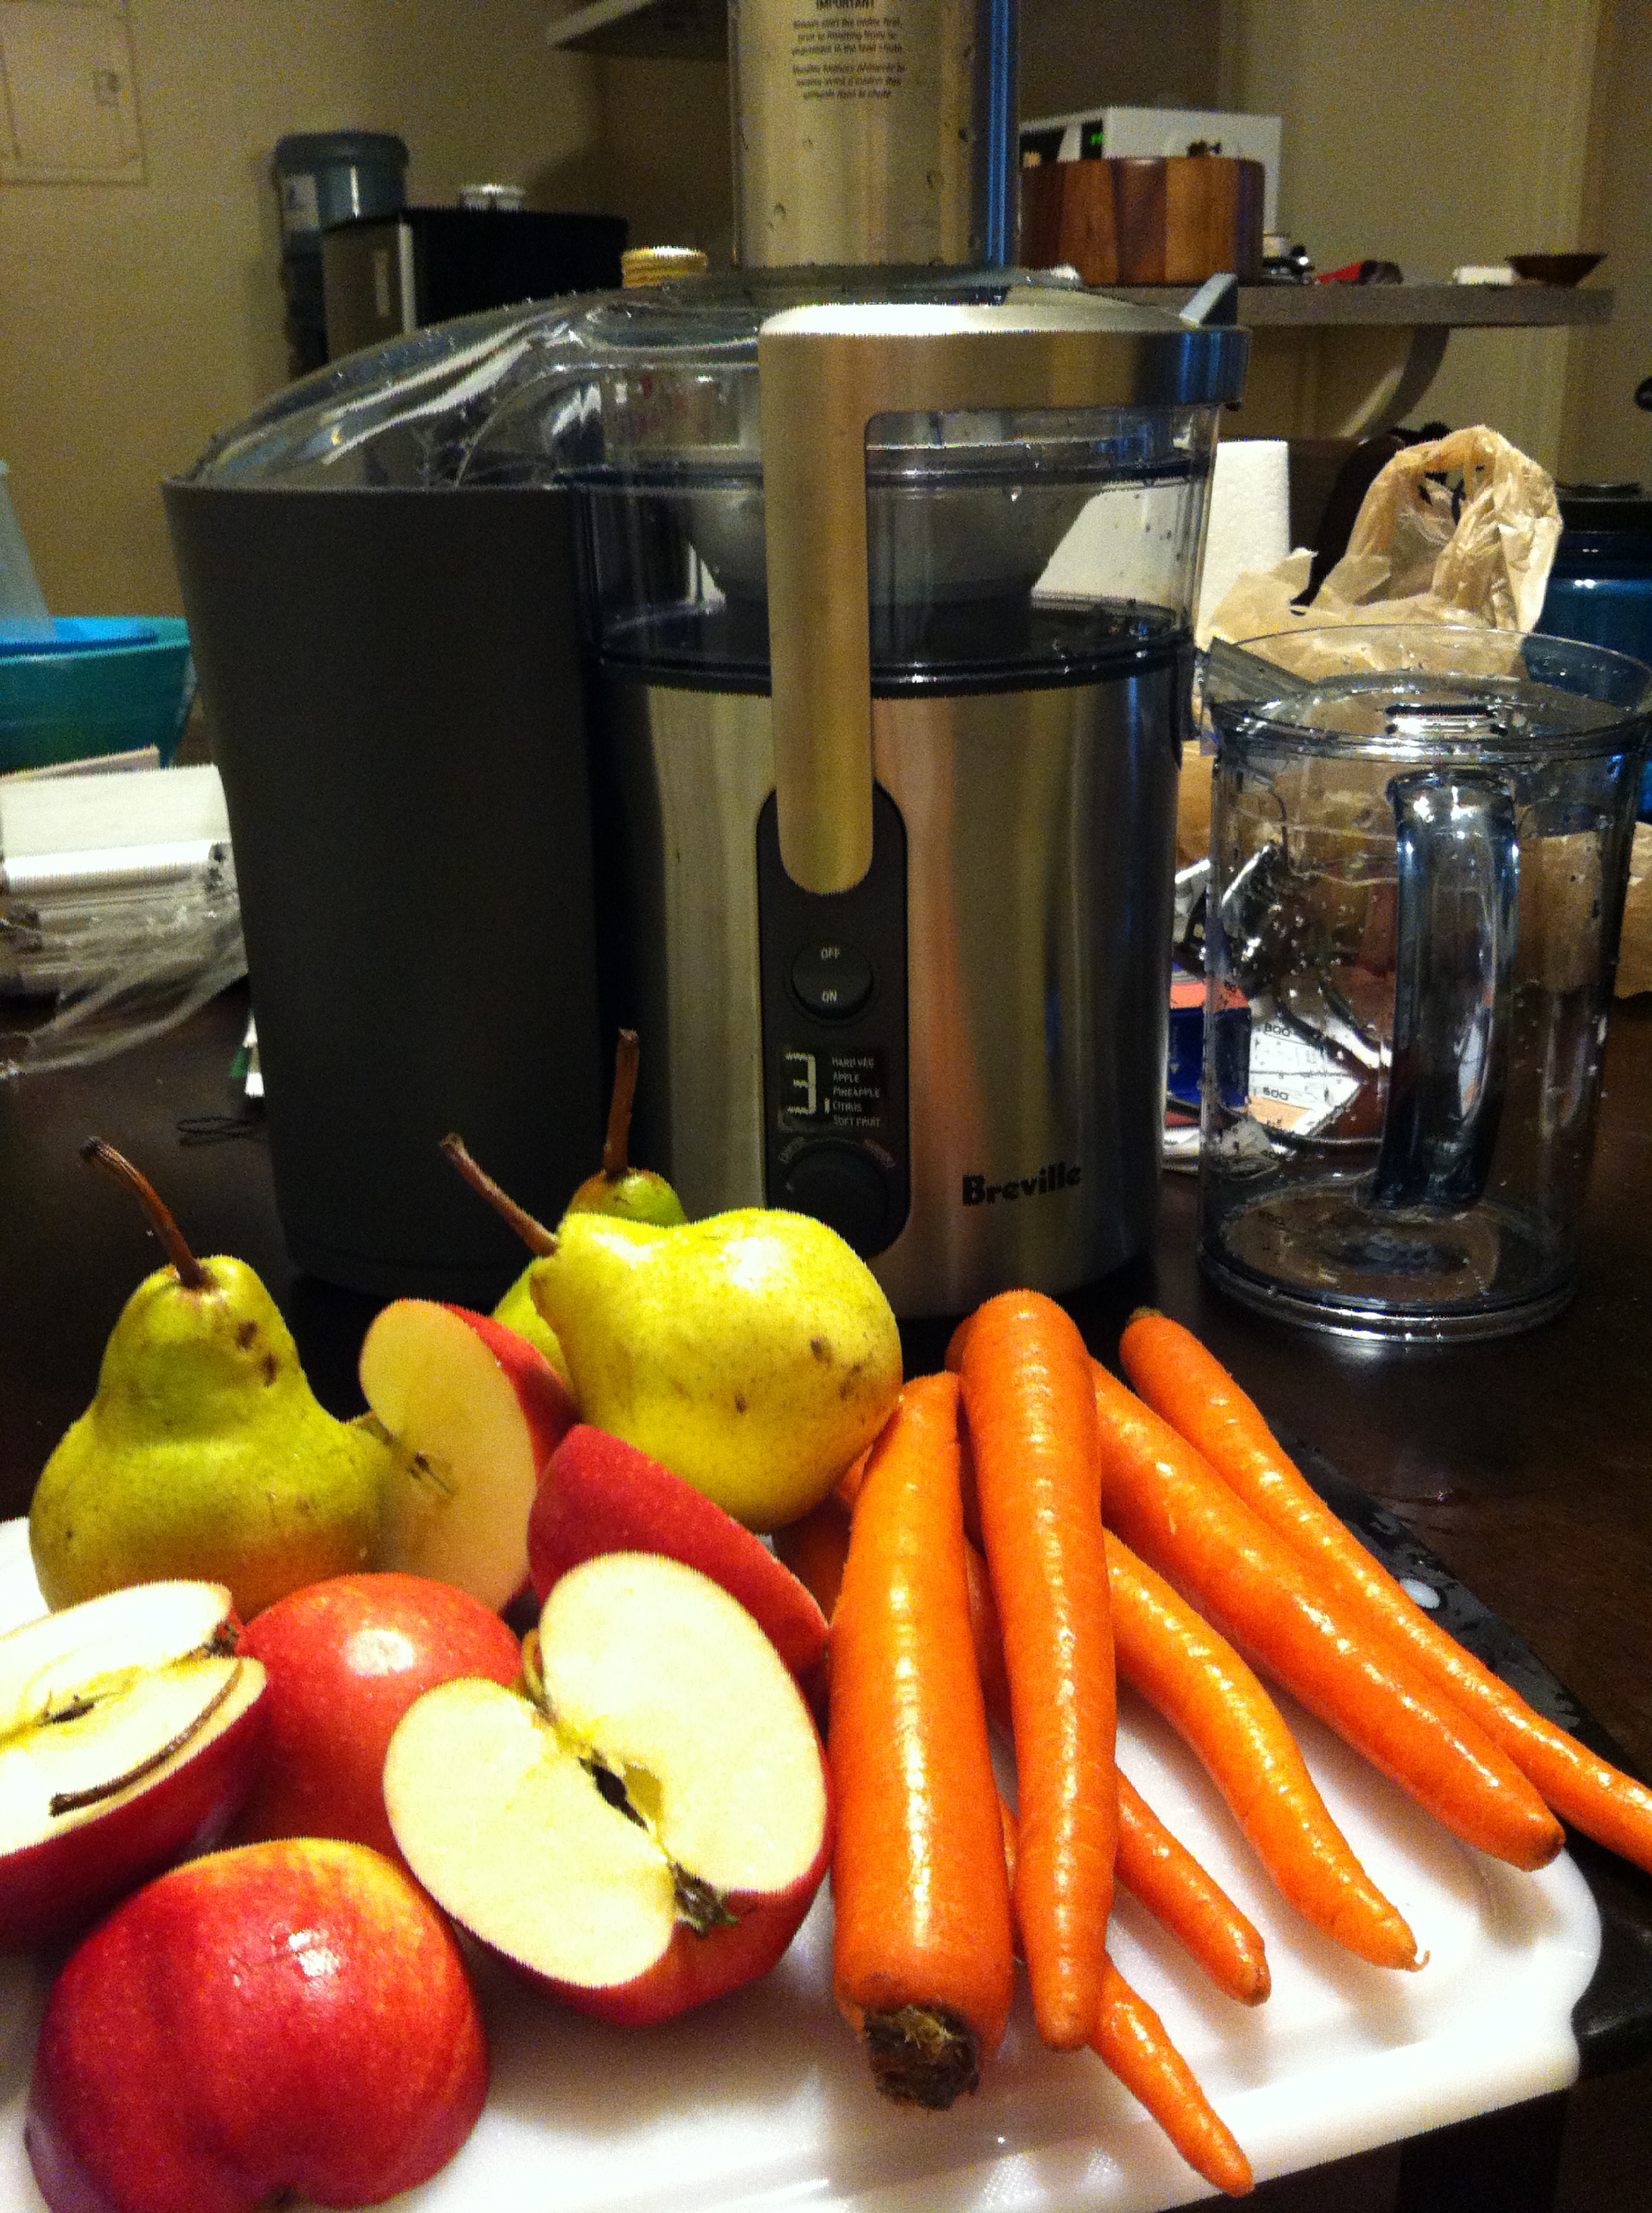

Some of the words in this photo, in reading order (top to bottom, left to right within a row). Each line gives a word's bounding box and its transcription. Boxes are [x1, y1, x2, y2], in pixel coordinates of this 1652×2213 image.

[820, 943, 840, 961] OFF
[820, 989, 838, 1004] ON
[832, 1055, 855, 1068] HARD
[832, 1070, 861, 1083] APPLE
[832, 1084, 881, 1099] PINEAPPLE
[832, 1098, 863, 1112] CITRUS
[832, 1113, 854, 1126] SOFT
[855, 1114, 882, 1129] FRUIT
[961, 1160, 1083, 1207] Breville
